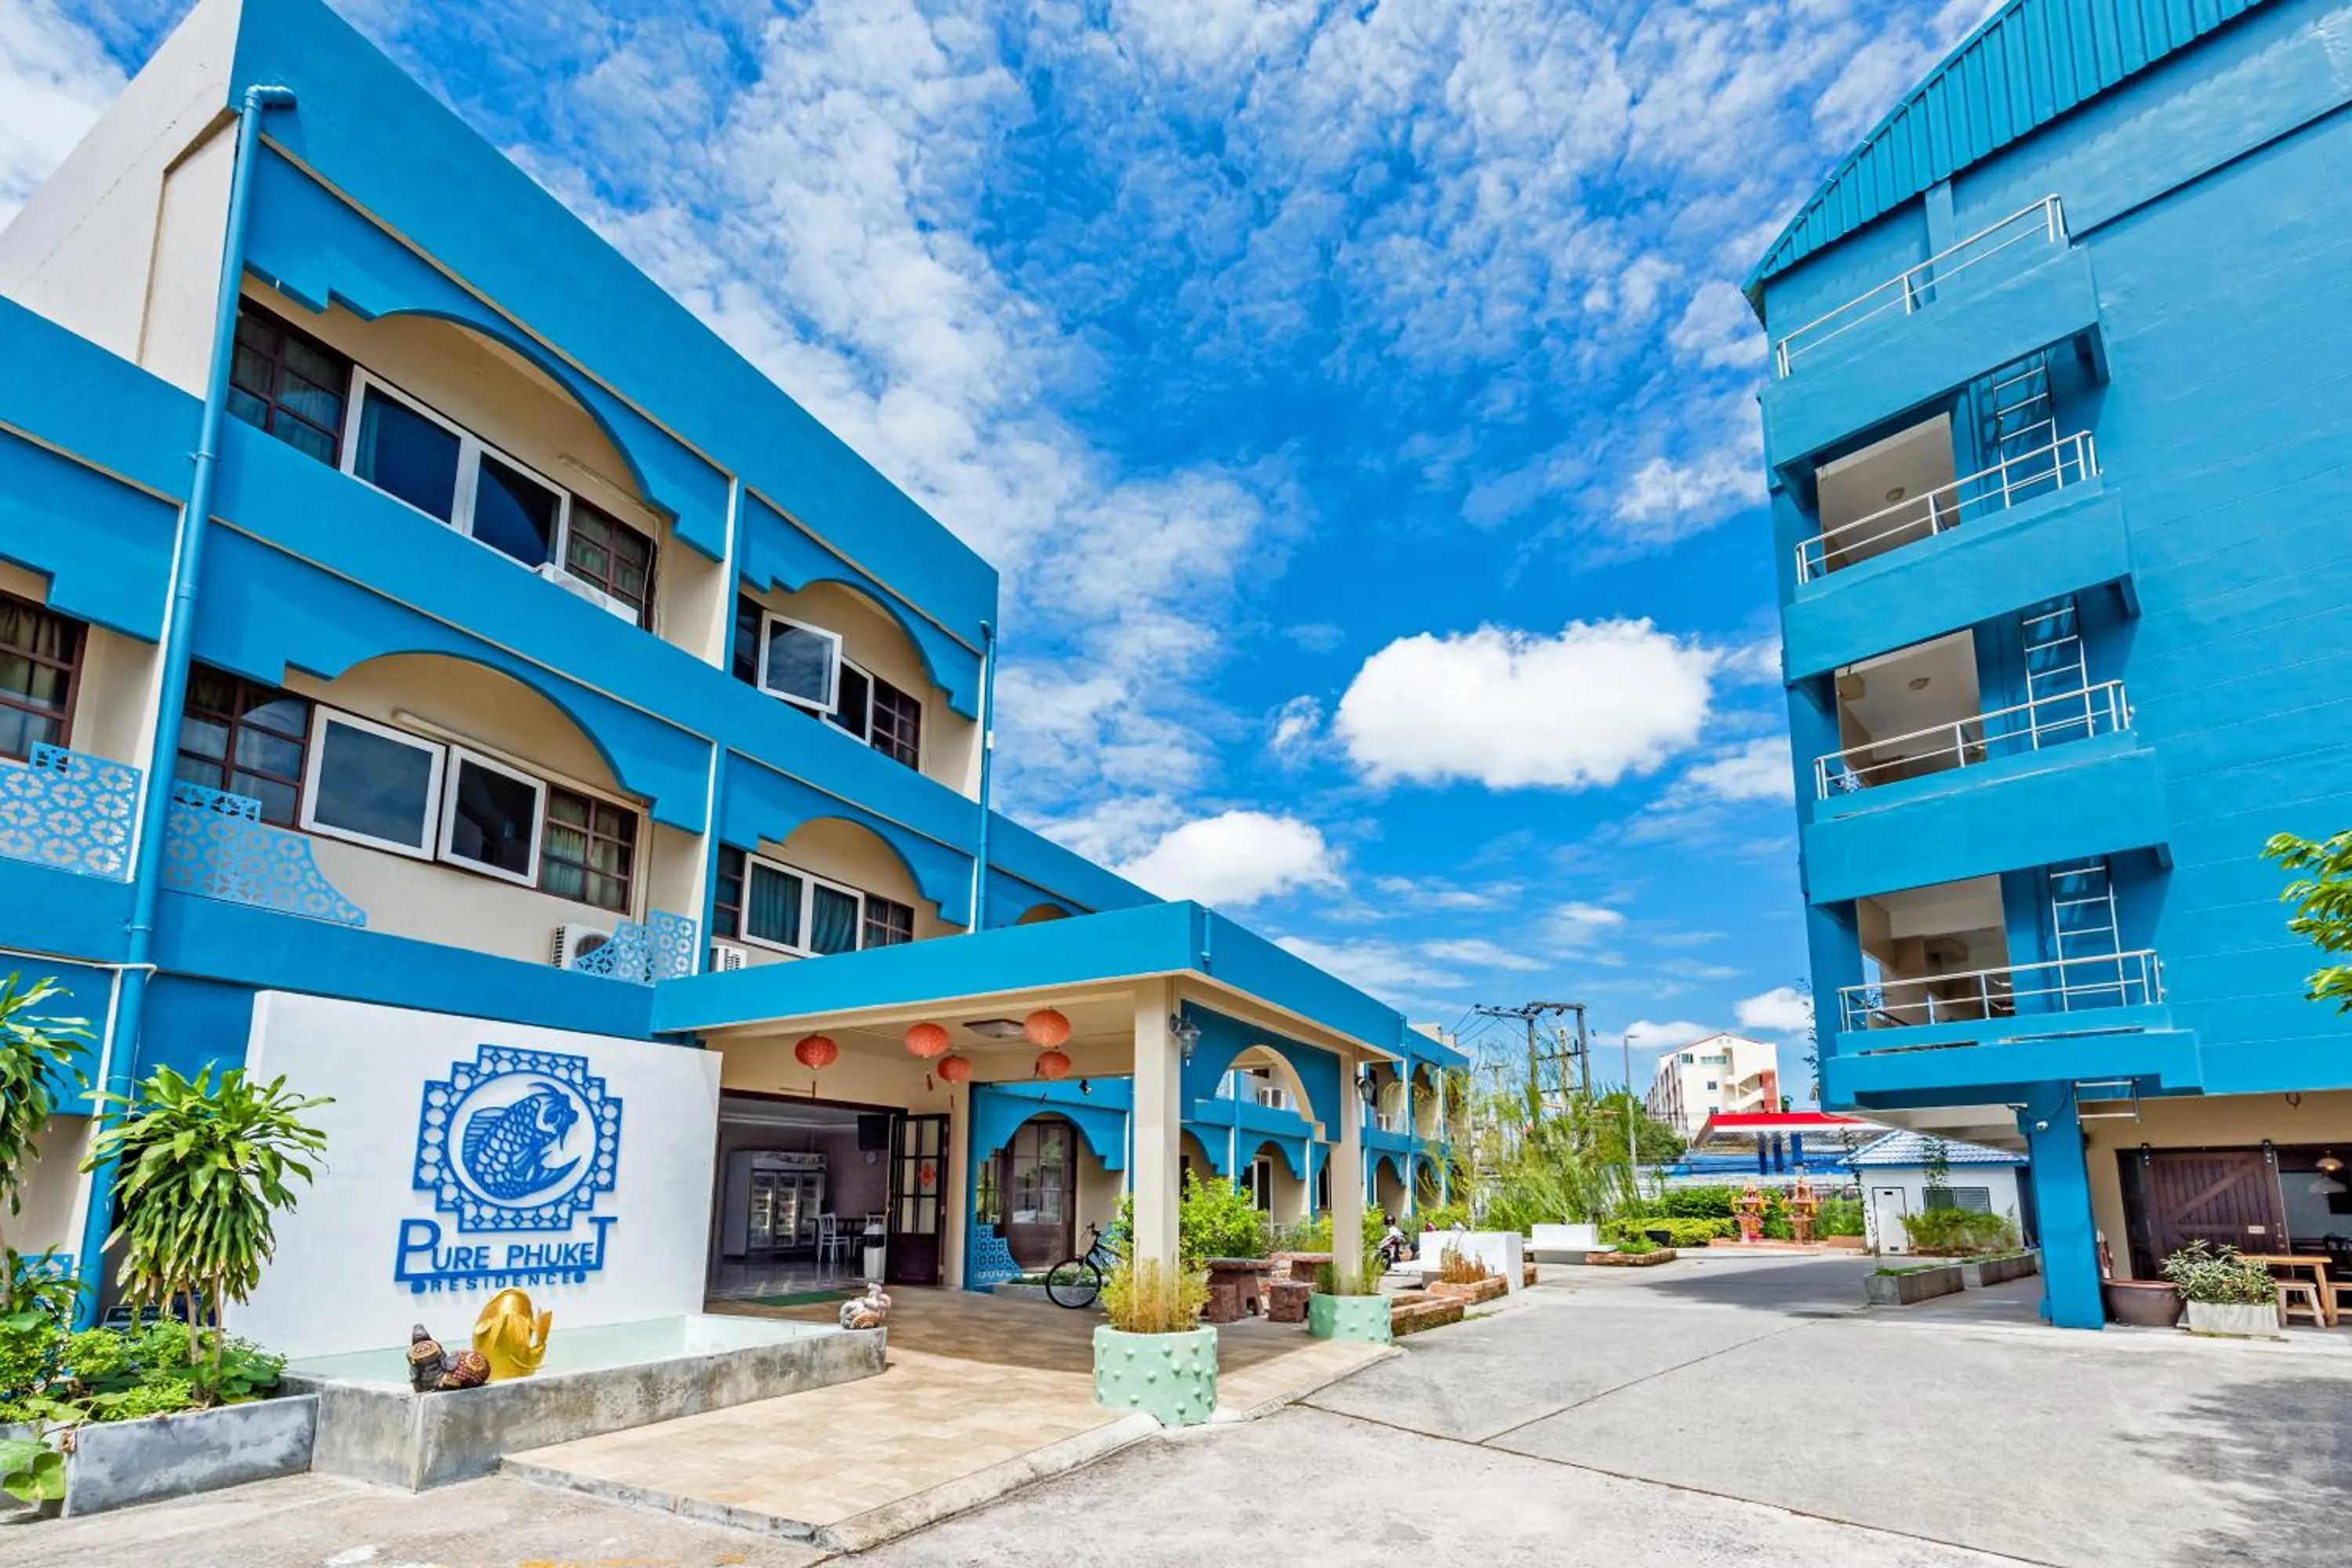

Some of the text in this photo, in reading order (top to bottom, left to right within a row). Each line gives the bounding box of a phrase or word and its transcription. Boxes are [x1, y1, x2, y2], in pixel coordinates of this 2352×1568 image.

[394, 1217, 618, 1281] PURE PHUKET
[430, 1272, 572, 1293] RESIDENCE
